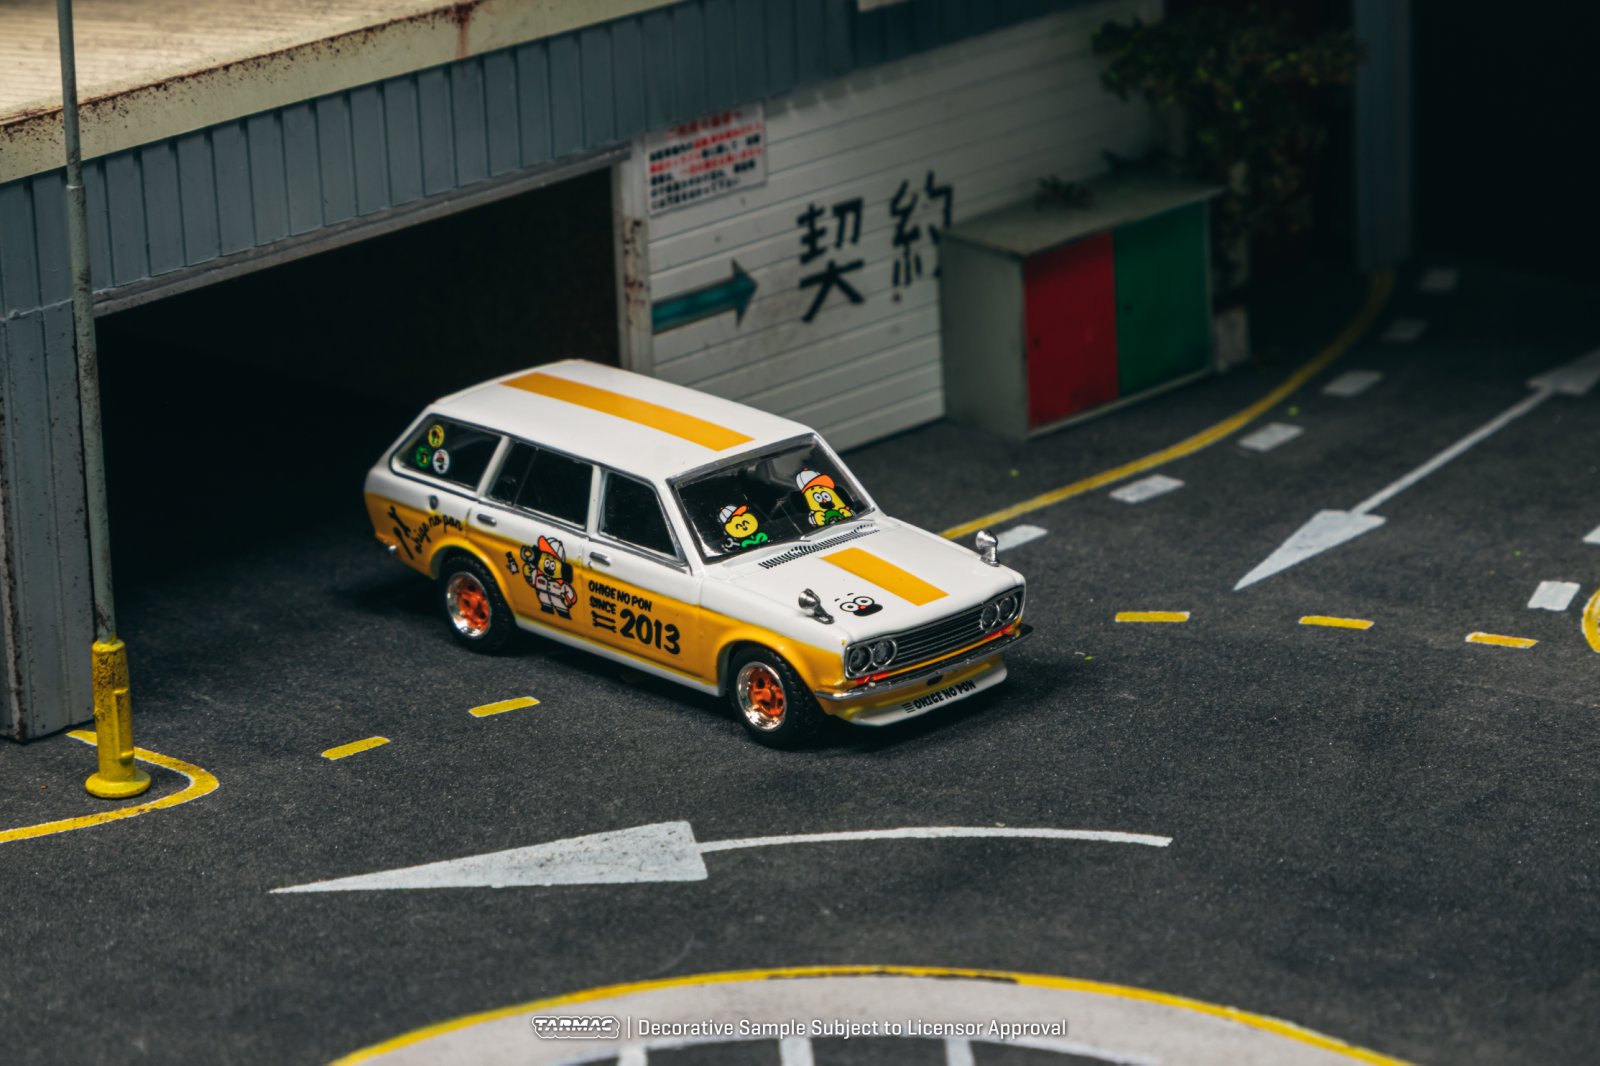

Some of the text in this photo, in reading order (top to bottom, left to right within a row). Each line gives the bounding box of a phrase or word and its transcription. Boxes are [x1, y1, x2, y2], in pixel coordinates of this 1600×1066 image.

[588, 580, 652, 613] OHIGE NO PON
[589, 595, 617, 615] SINCE
[620, 608, 681, 655] 2013
[912, 679, 977, 710] OHIGE NO PON
